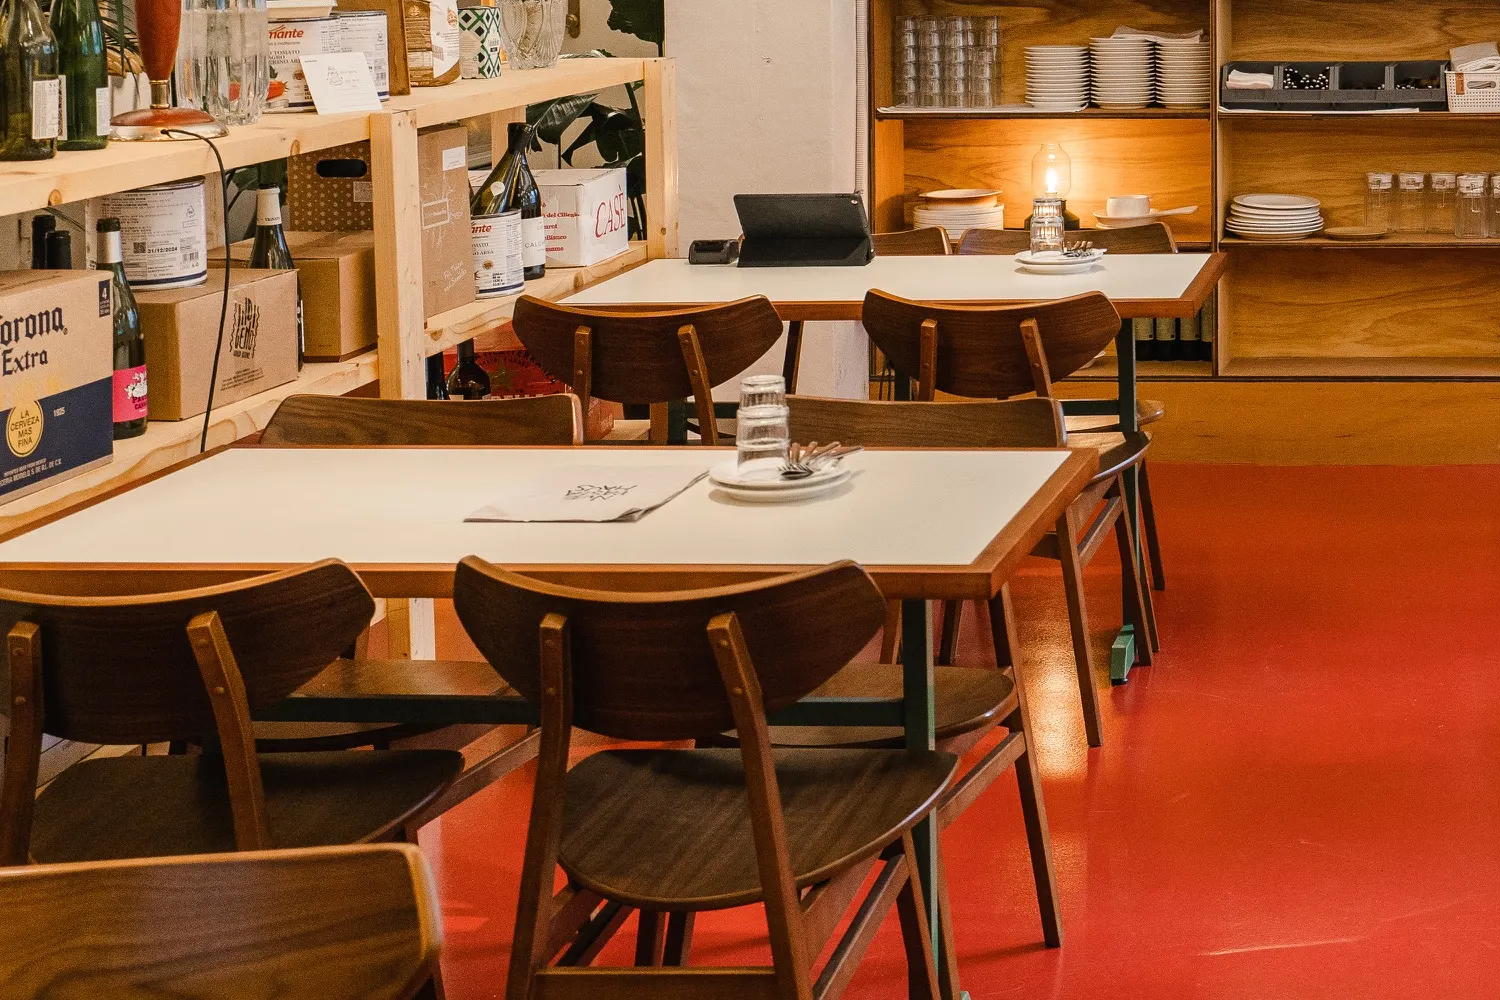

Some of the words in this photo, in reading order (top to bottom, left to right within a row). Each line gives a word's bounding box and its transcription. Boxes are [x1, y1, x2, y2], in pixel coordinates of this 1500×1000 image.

[102, 288, 107, 300] 4
[0, 306, 64, 347] orona
[2, 348, 48, 377] Extra
[20, 410, 30, 419] LA
[10, 415, 40, 431] CERVEZA
[18, 427, 33, 439] MAS
[18, 437, 33, 449] FINA
